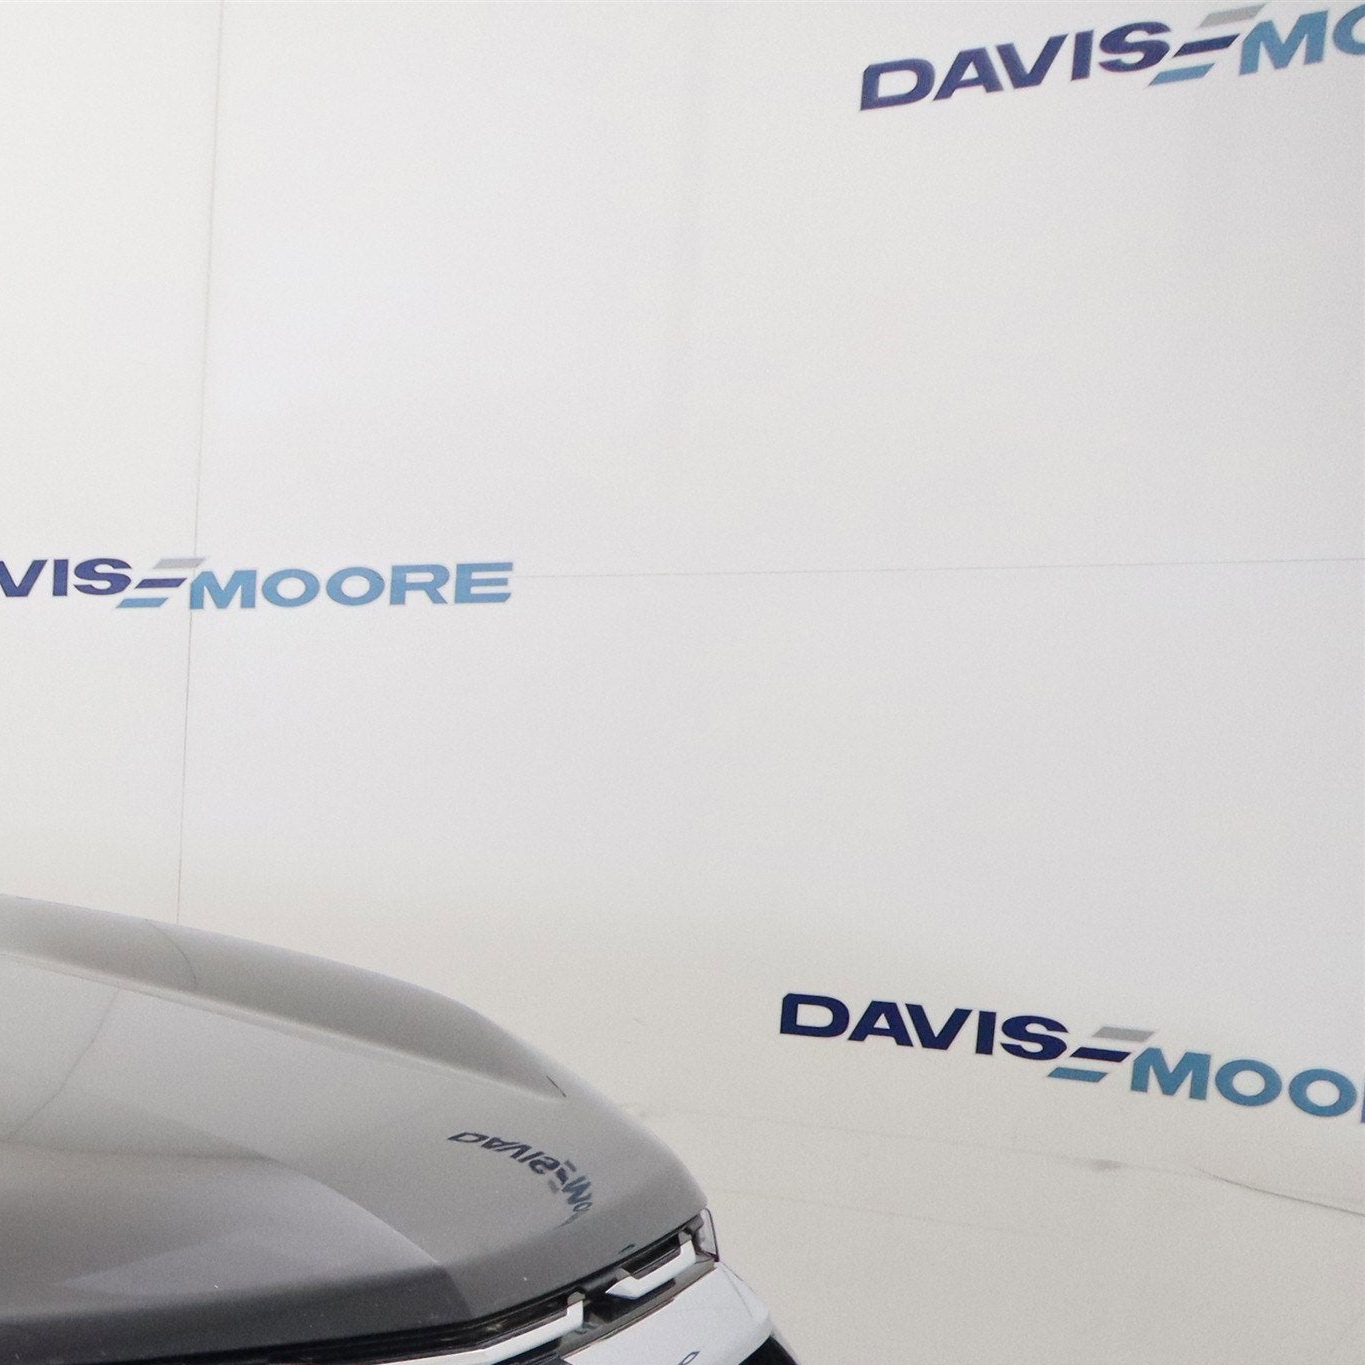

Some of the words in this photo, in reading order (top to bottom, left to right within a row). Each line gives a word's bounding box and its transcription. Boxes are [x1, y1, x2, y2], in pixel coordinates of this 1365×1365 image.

[860, 21, 1170, 111] DAVIS
[189, 562, 514, 610] MOORE
[779, 993, 1069, 1061] DAVIS
[1130, 1048, 1365, 1124] MOO
